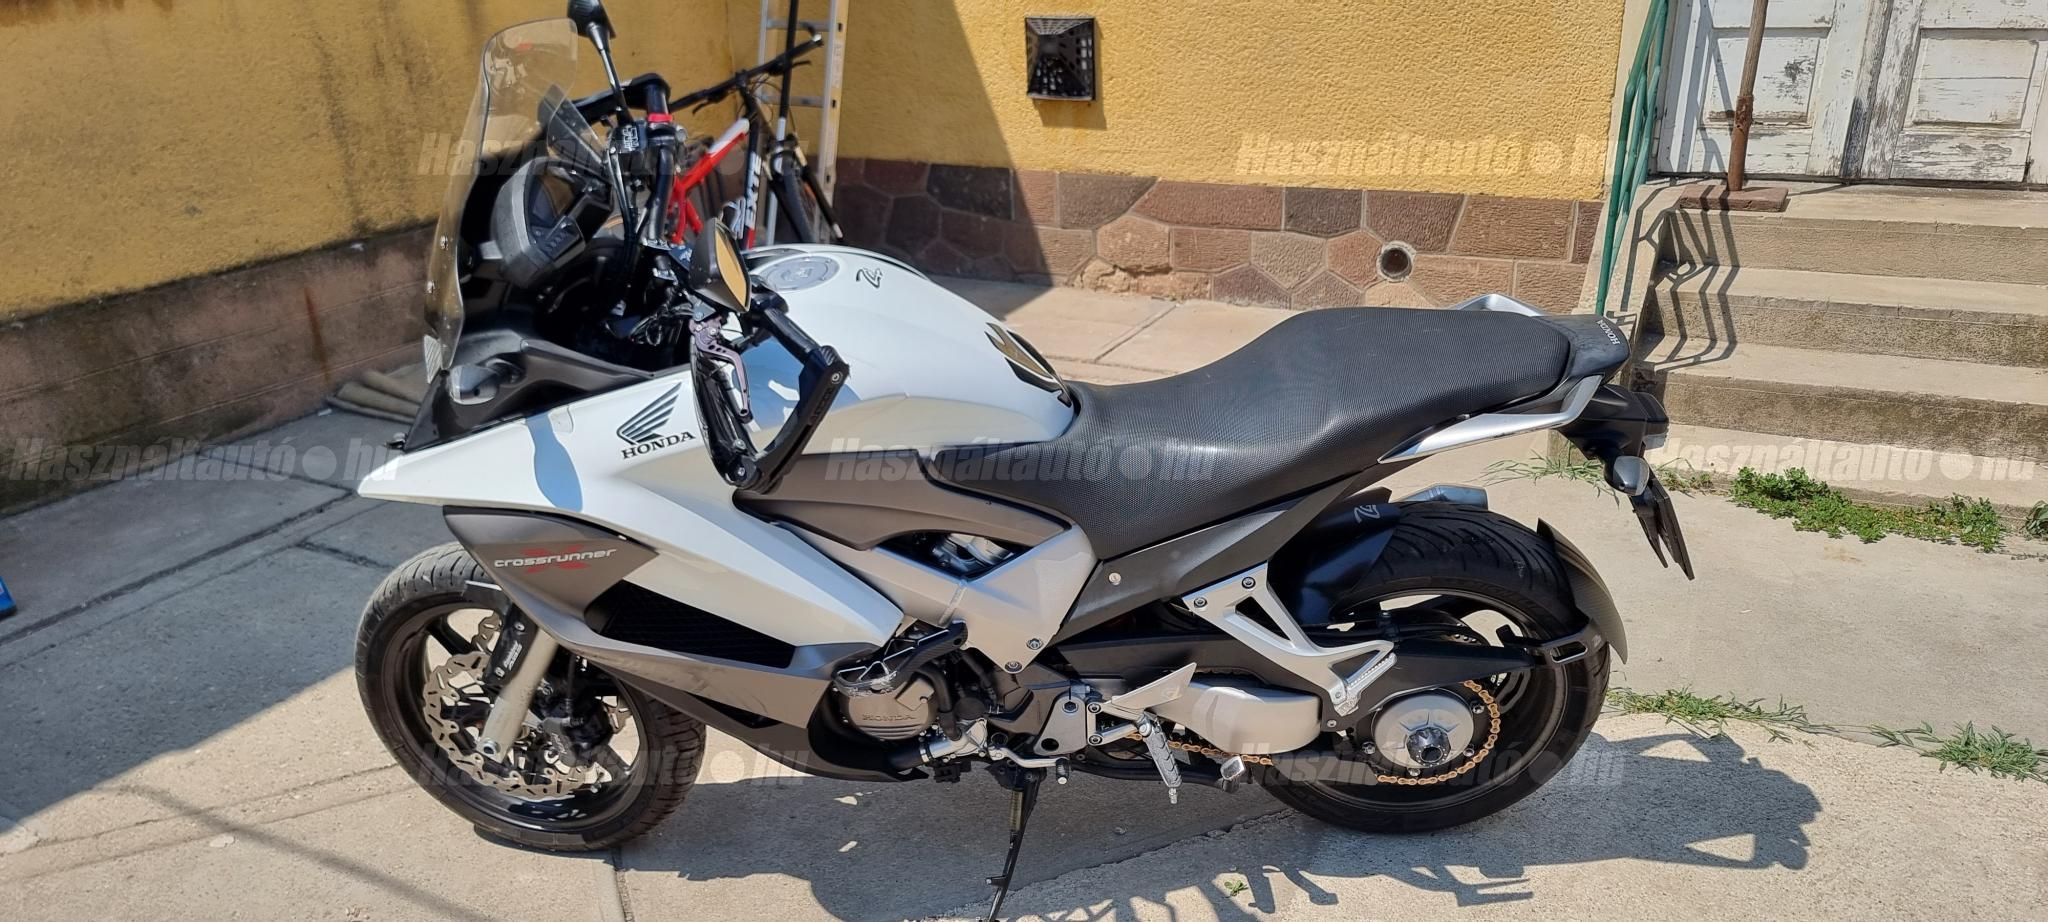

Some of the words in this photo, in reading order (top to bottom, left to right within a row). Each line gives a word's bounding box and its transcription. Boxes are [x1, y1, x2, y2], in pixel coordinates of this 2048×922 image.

[1597, 319, 1620, 345] HONDA
[621, 430, 697, 460] HONDA
[494, 548, 617, 569] crossrunner
[862, 713, 916, 722] HONDA
